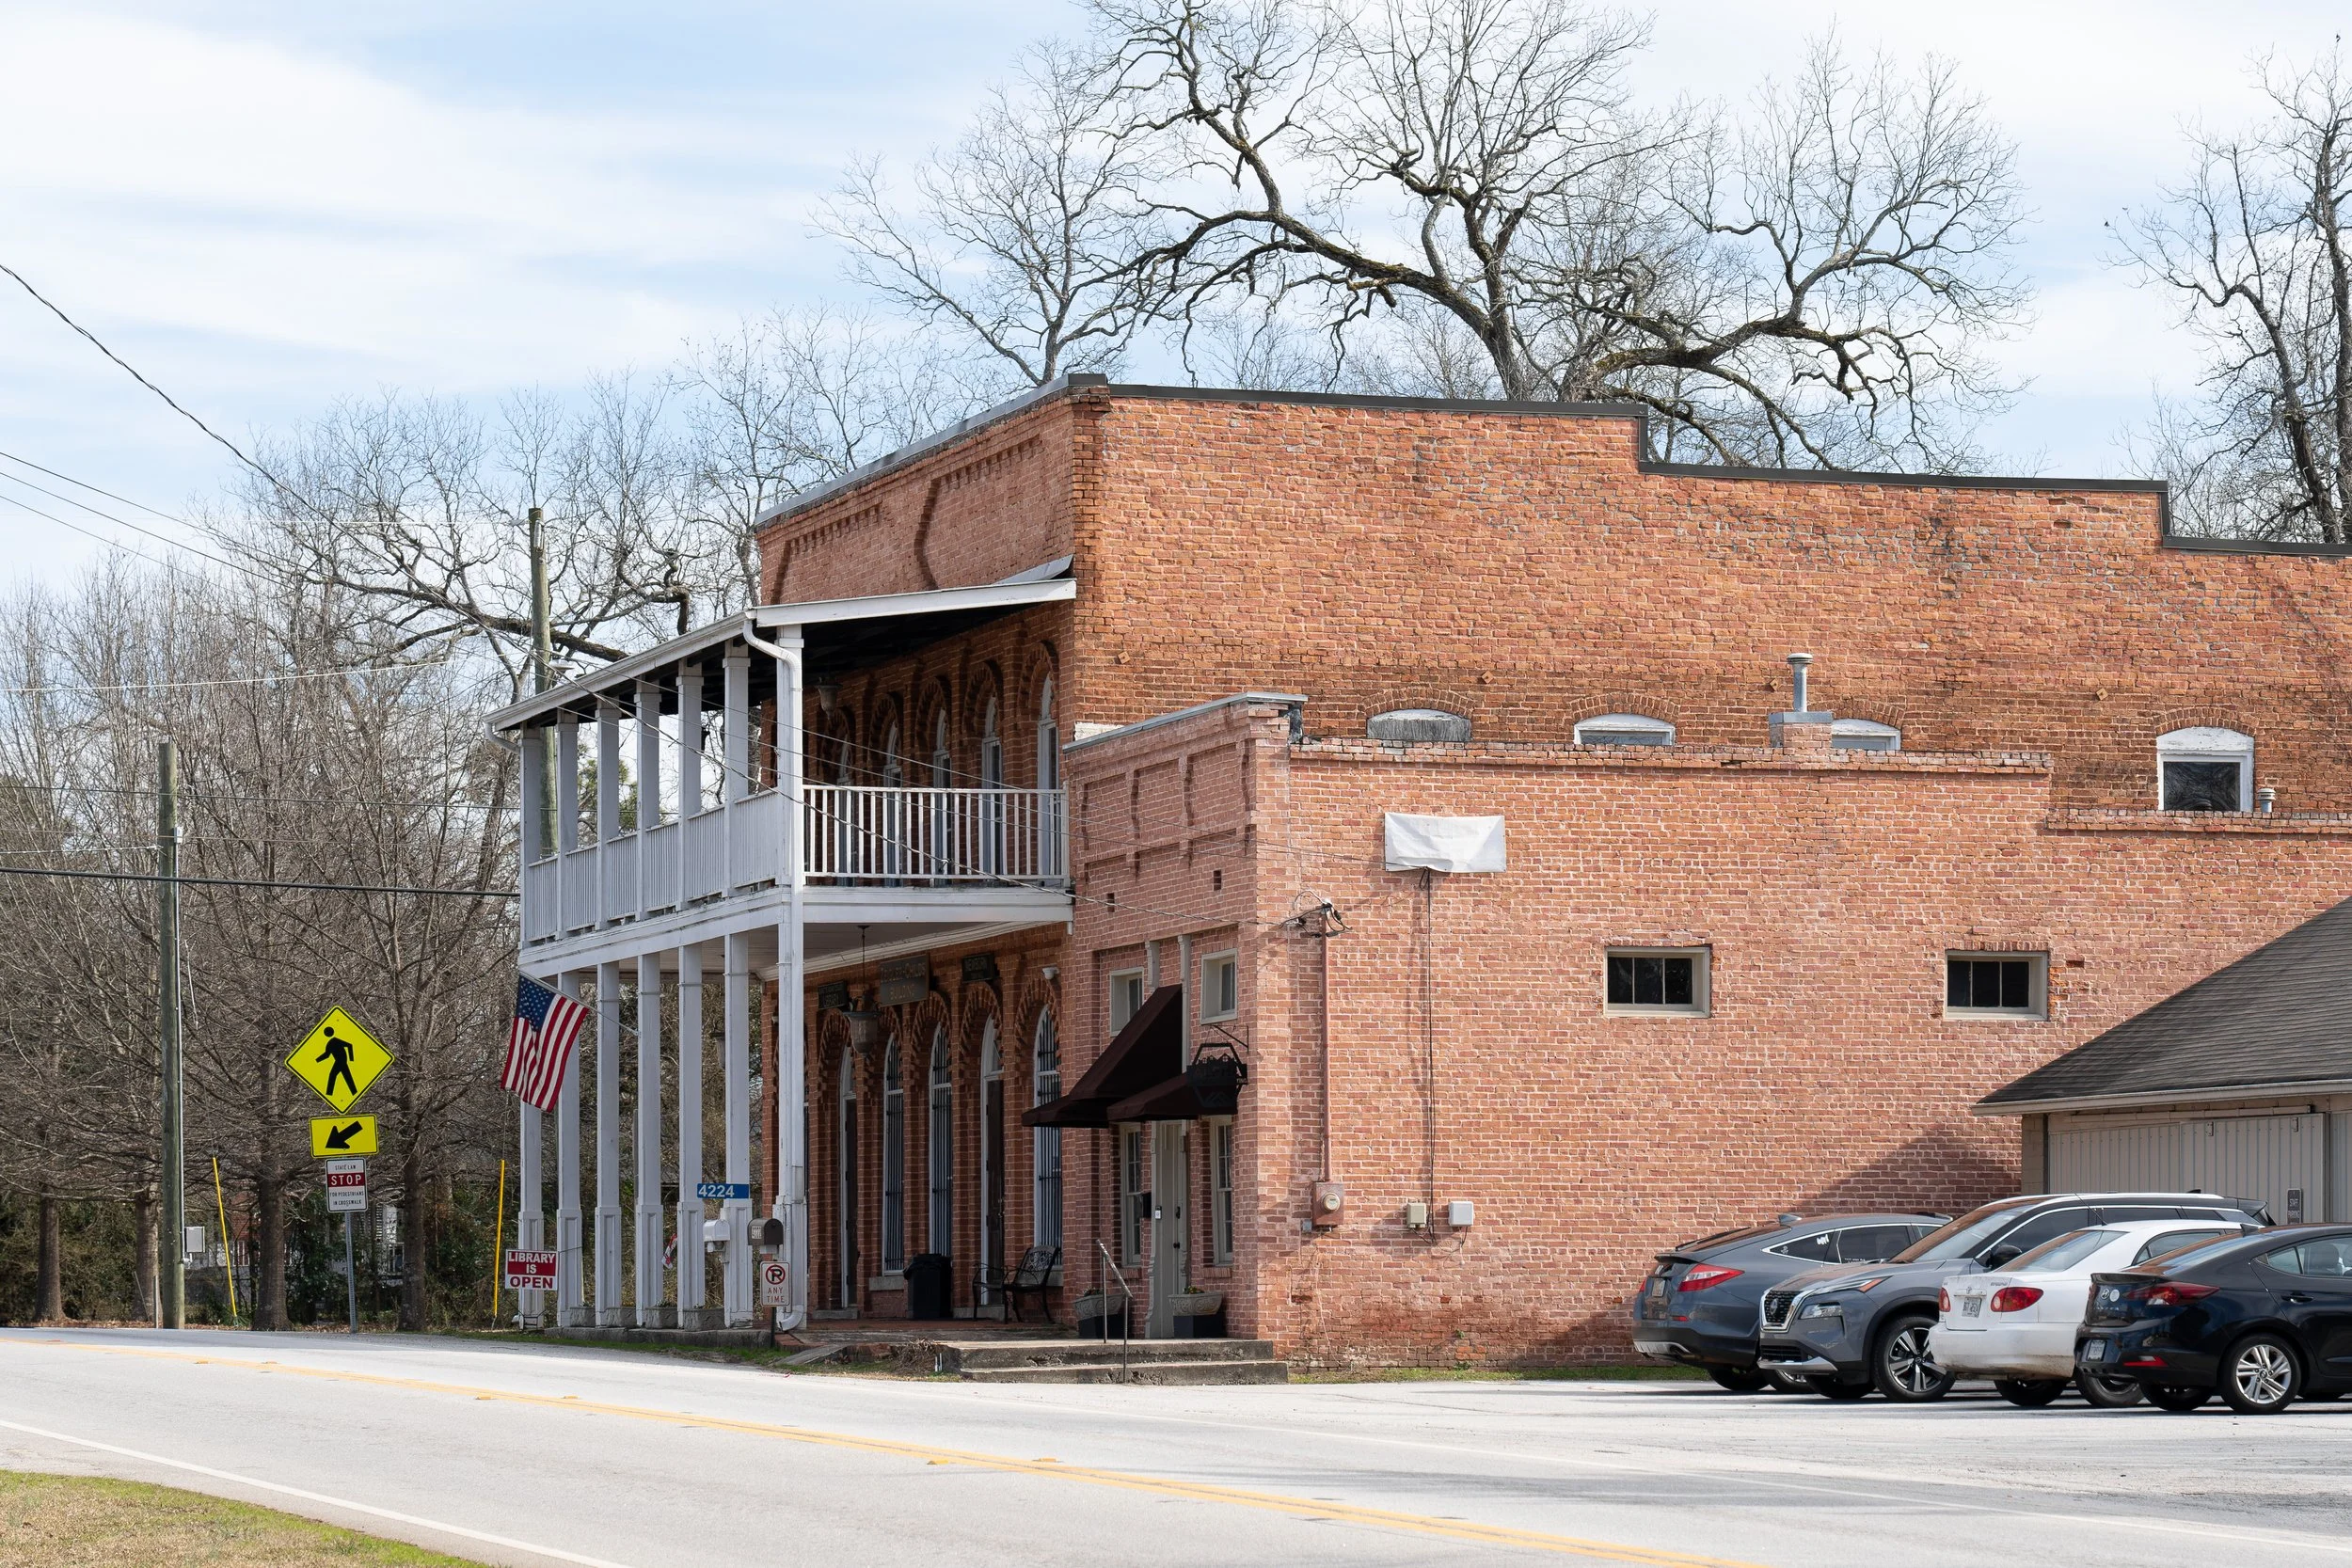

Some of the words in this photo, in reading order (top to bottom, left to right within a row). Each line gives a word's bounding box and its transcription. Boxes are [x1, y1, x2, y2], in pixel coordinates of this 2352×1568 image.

[331, 1175, 361, 1185] STOP
[698, 1184, 735, 1197] 4224
[508, 1252, 555, 1263] LIBRARY
[526, 1264, 537, 1274] IS
[510, 1275, 553, 1289] OPEN
